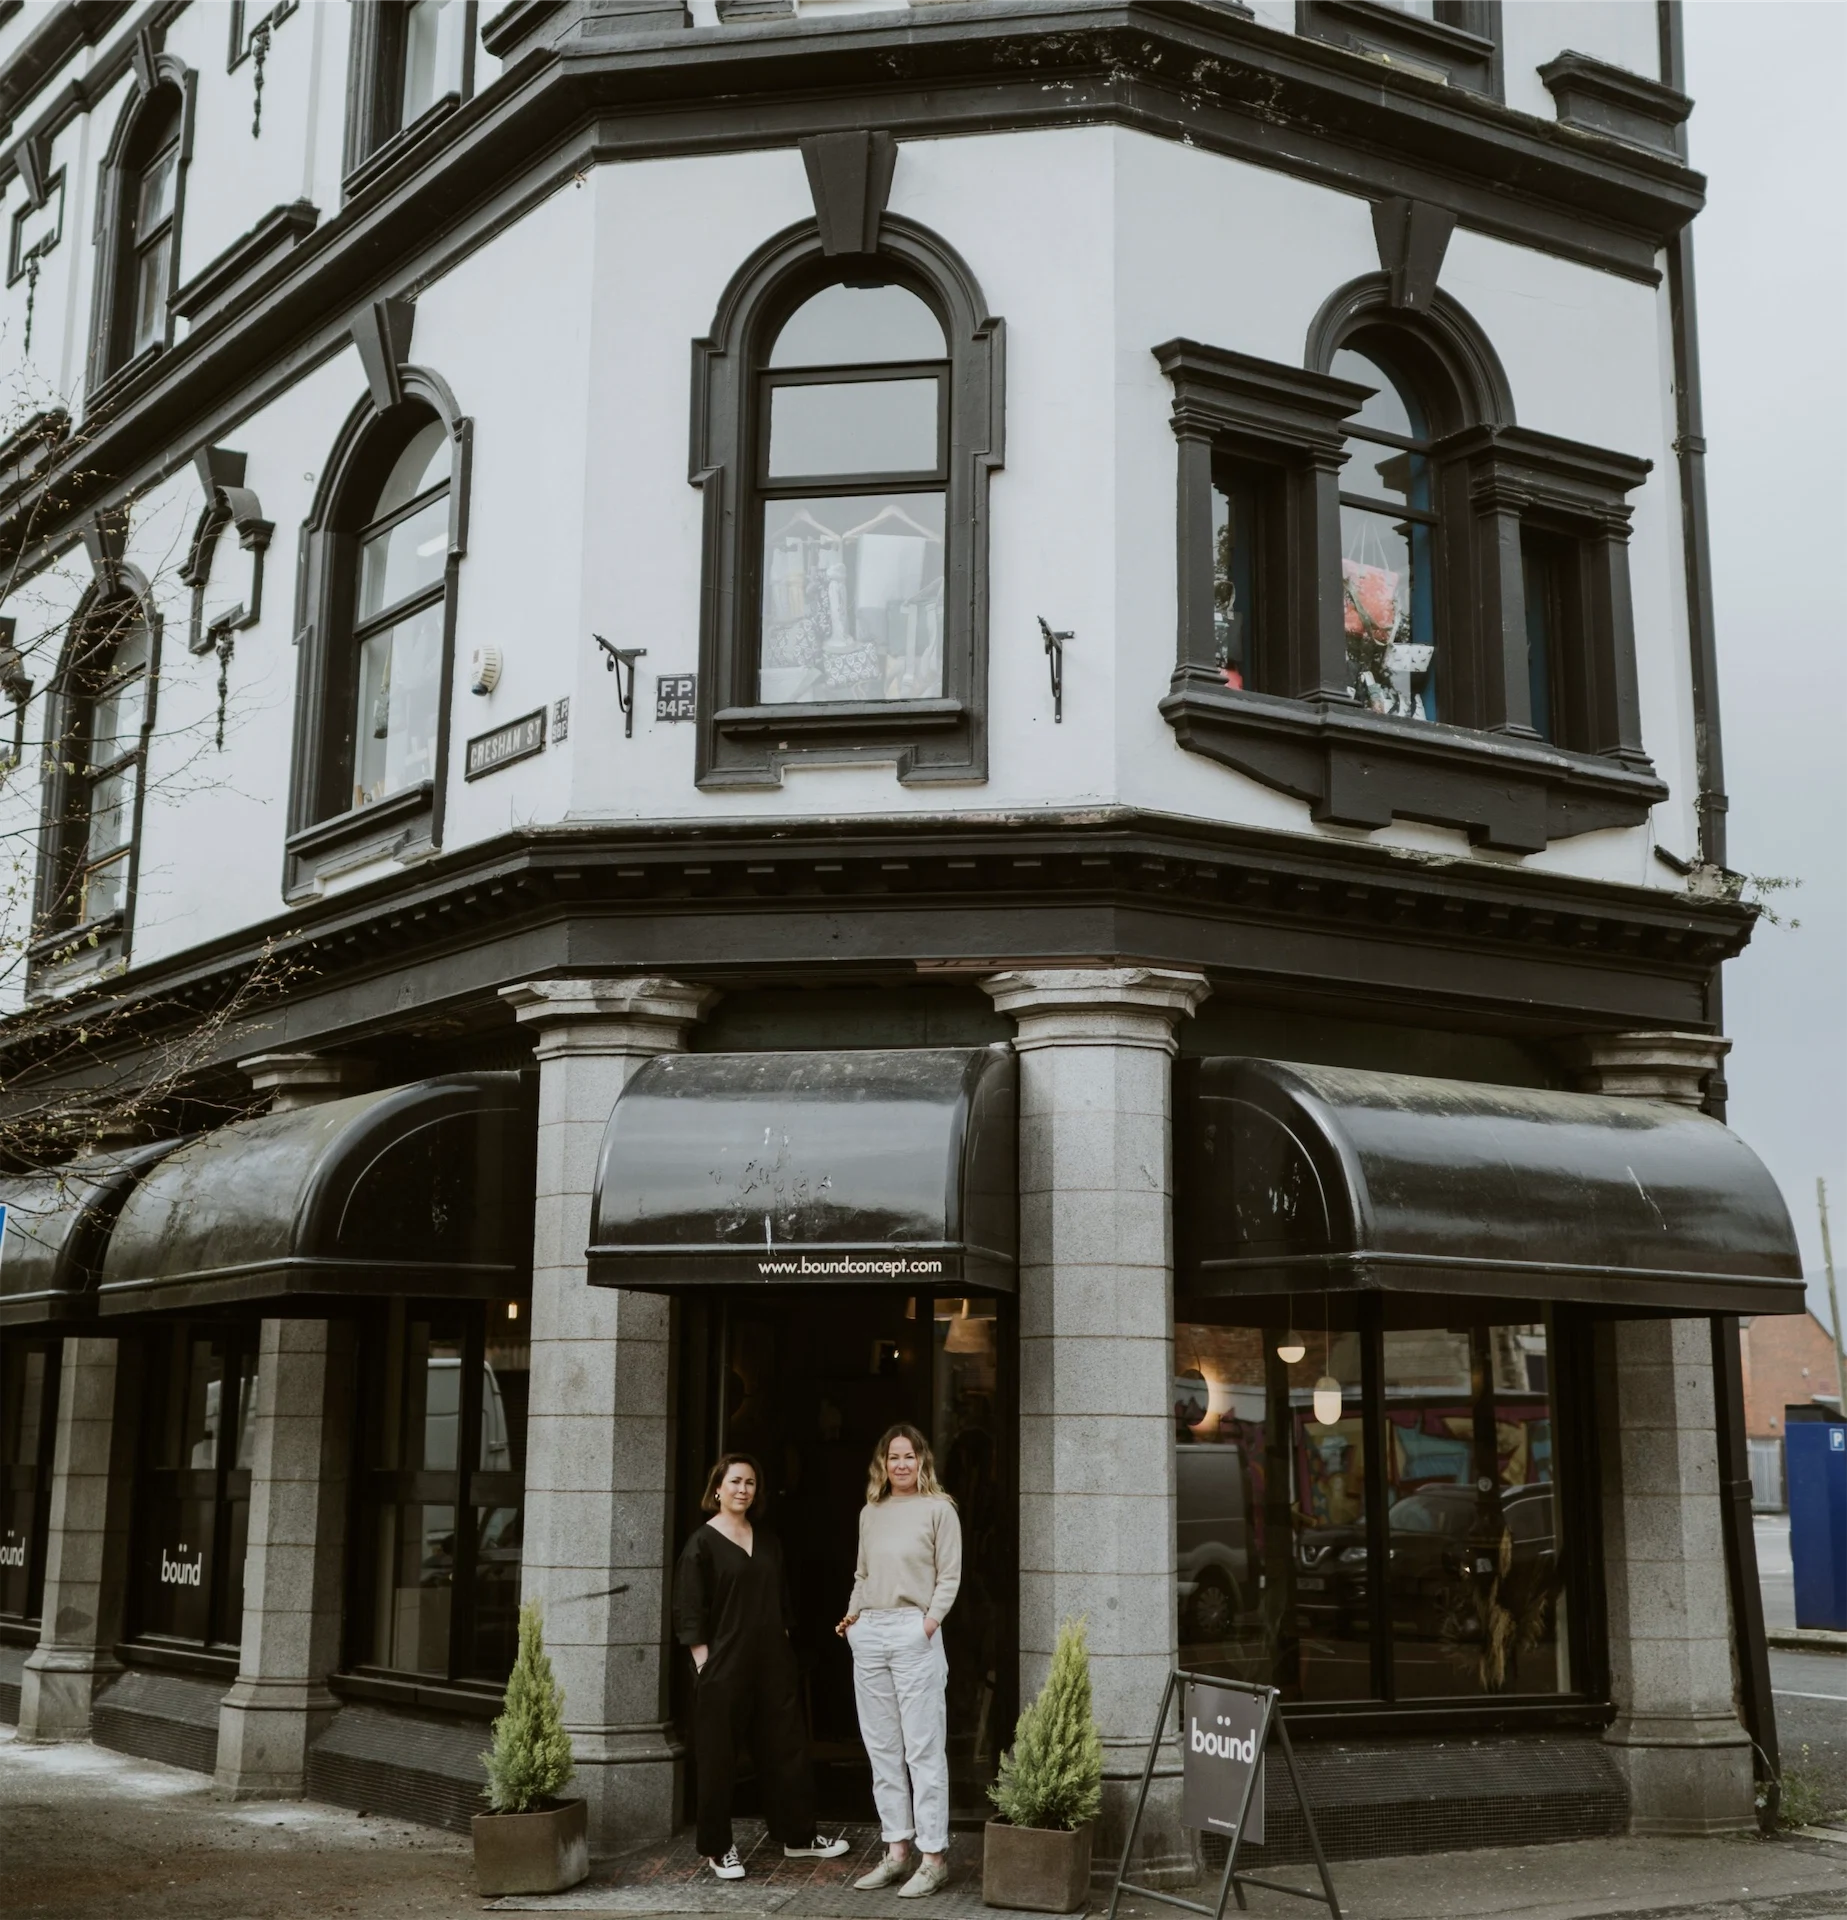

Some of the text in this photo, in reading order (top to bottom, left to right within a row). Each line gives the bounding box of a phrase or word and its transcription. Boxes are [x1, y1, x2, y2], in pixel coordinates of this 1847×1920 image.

[661, 680, 692, 697] F.P.
[527, 719, 541, 745] ST
[758, 1255, 942, 1278] www.boundconcept.com
[1834, 1428, 1842, 1446] P
[0, 1529, 26, 1566] oünd
[161, 1543, 202, 1586] boünd
[1191, 1714, 1256, 1764] boünd
